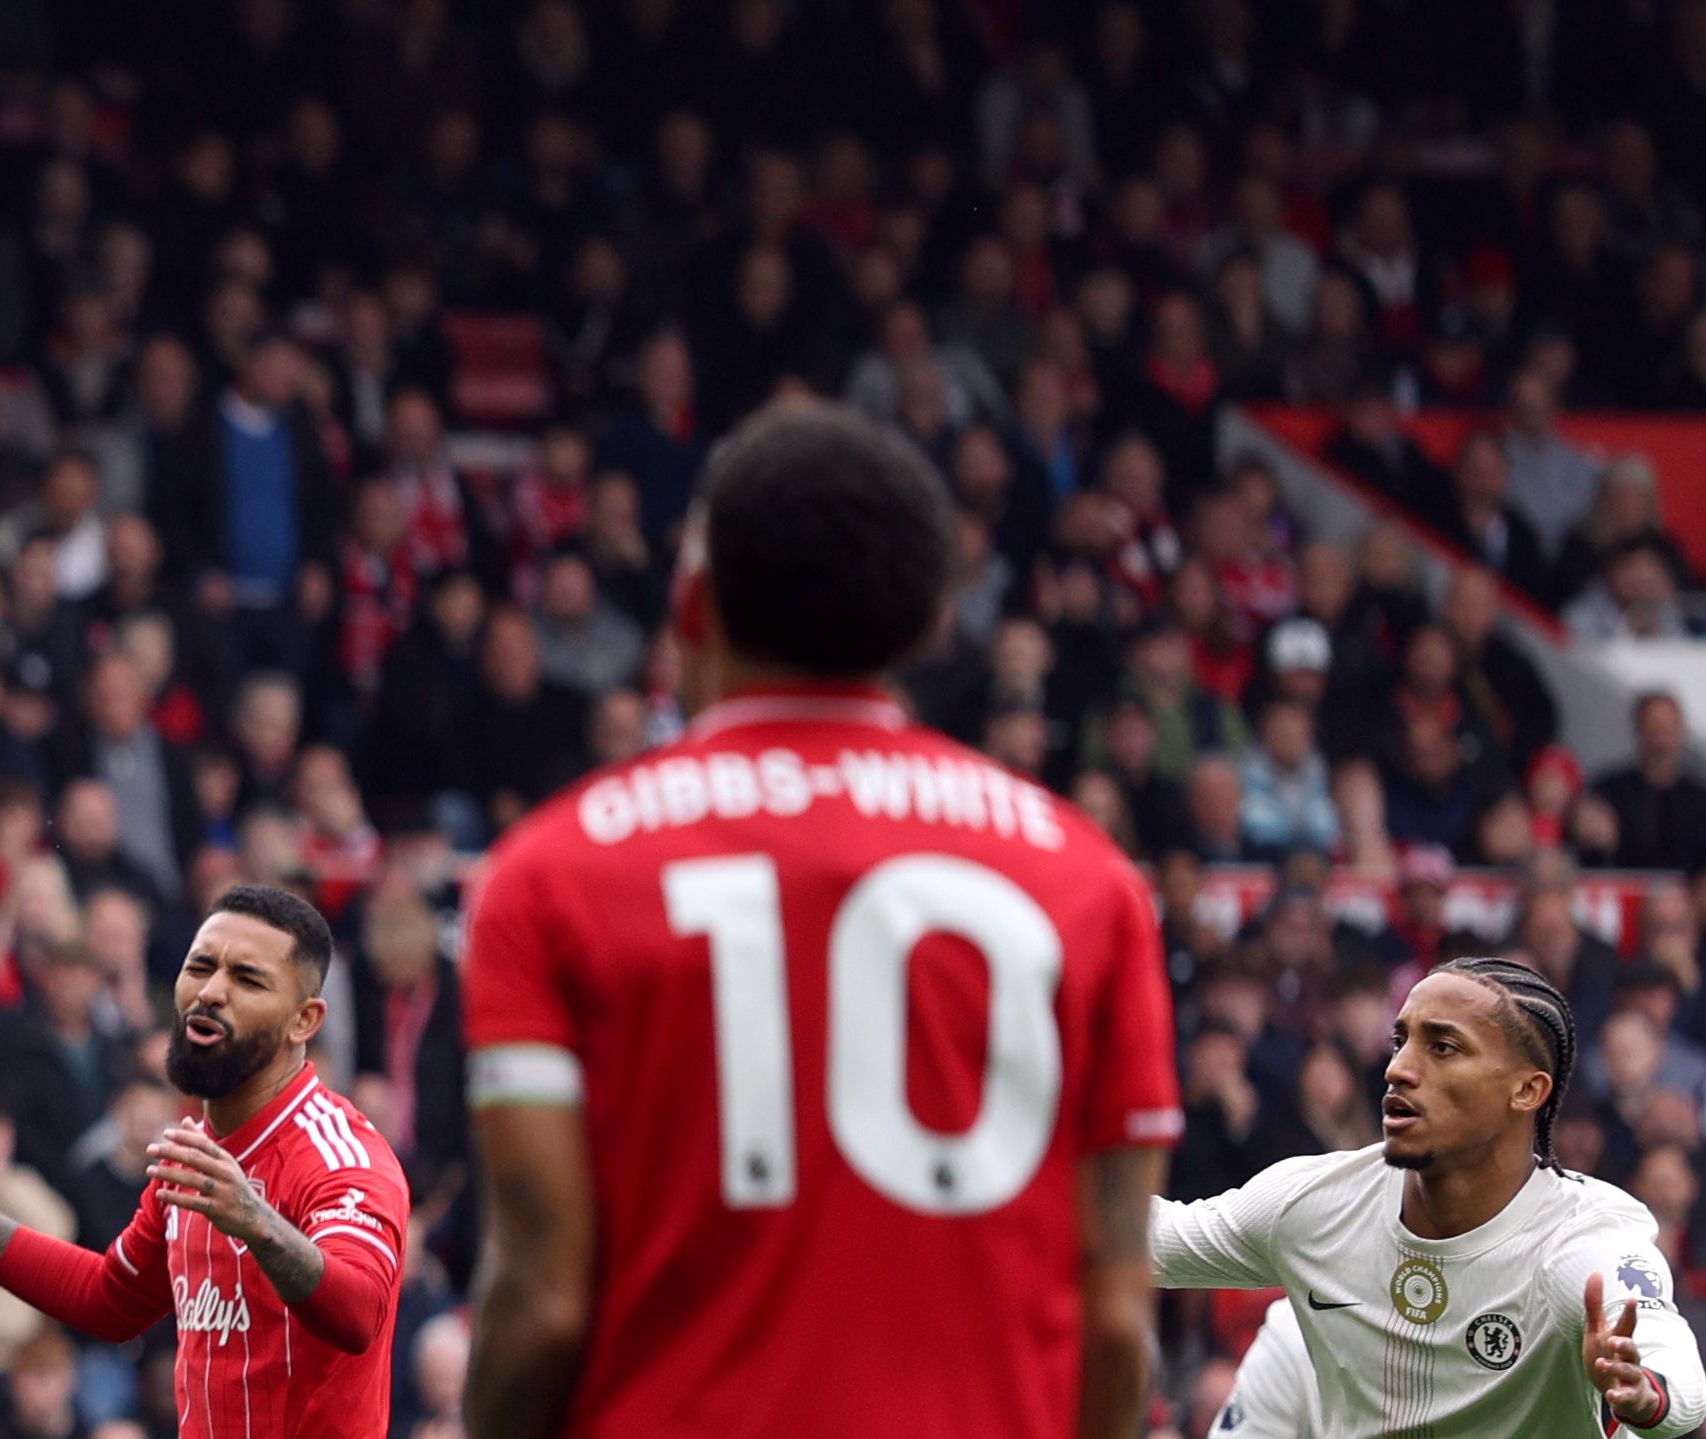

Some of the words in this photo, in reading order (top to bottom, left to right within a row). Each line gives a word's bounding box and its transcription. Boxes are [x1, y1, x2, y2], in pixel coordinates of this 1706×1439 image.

[579, 748, 1066, 851] GIBBS-WHITE
[661, 853, 1065, 1216] 10
[173, 1275, 251, 1346] Bally's
[1395, 1266, 1412, 1294] WORLD
[1412, 1264, 1444, 1304] CHAMPIONS
[1405, 1307, 1428, 1320] FIFA
[1475, 1315, 1514, 1329] CHELSEA
